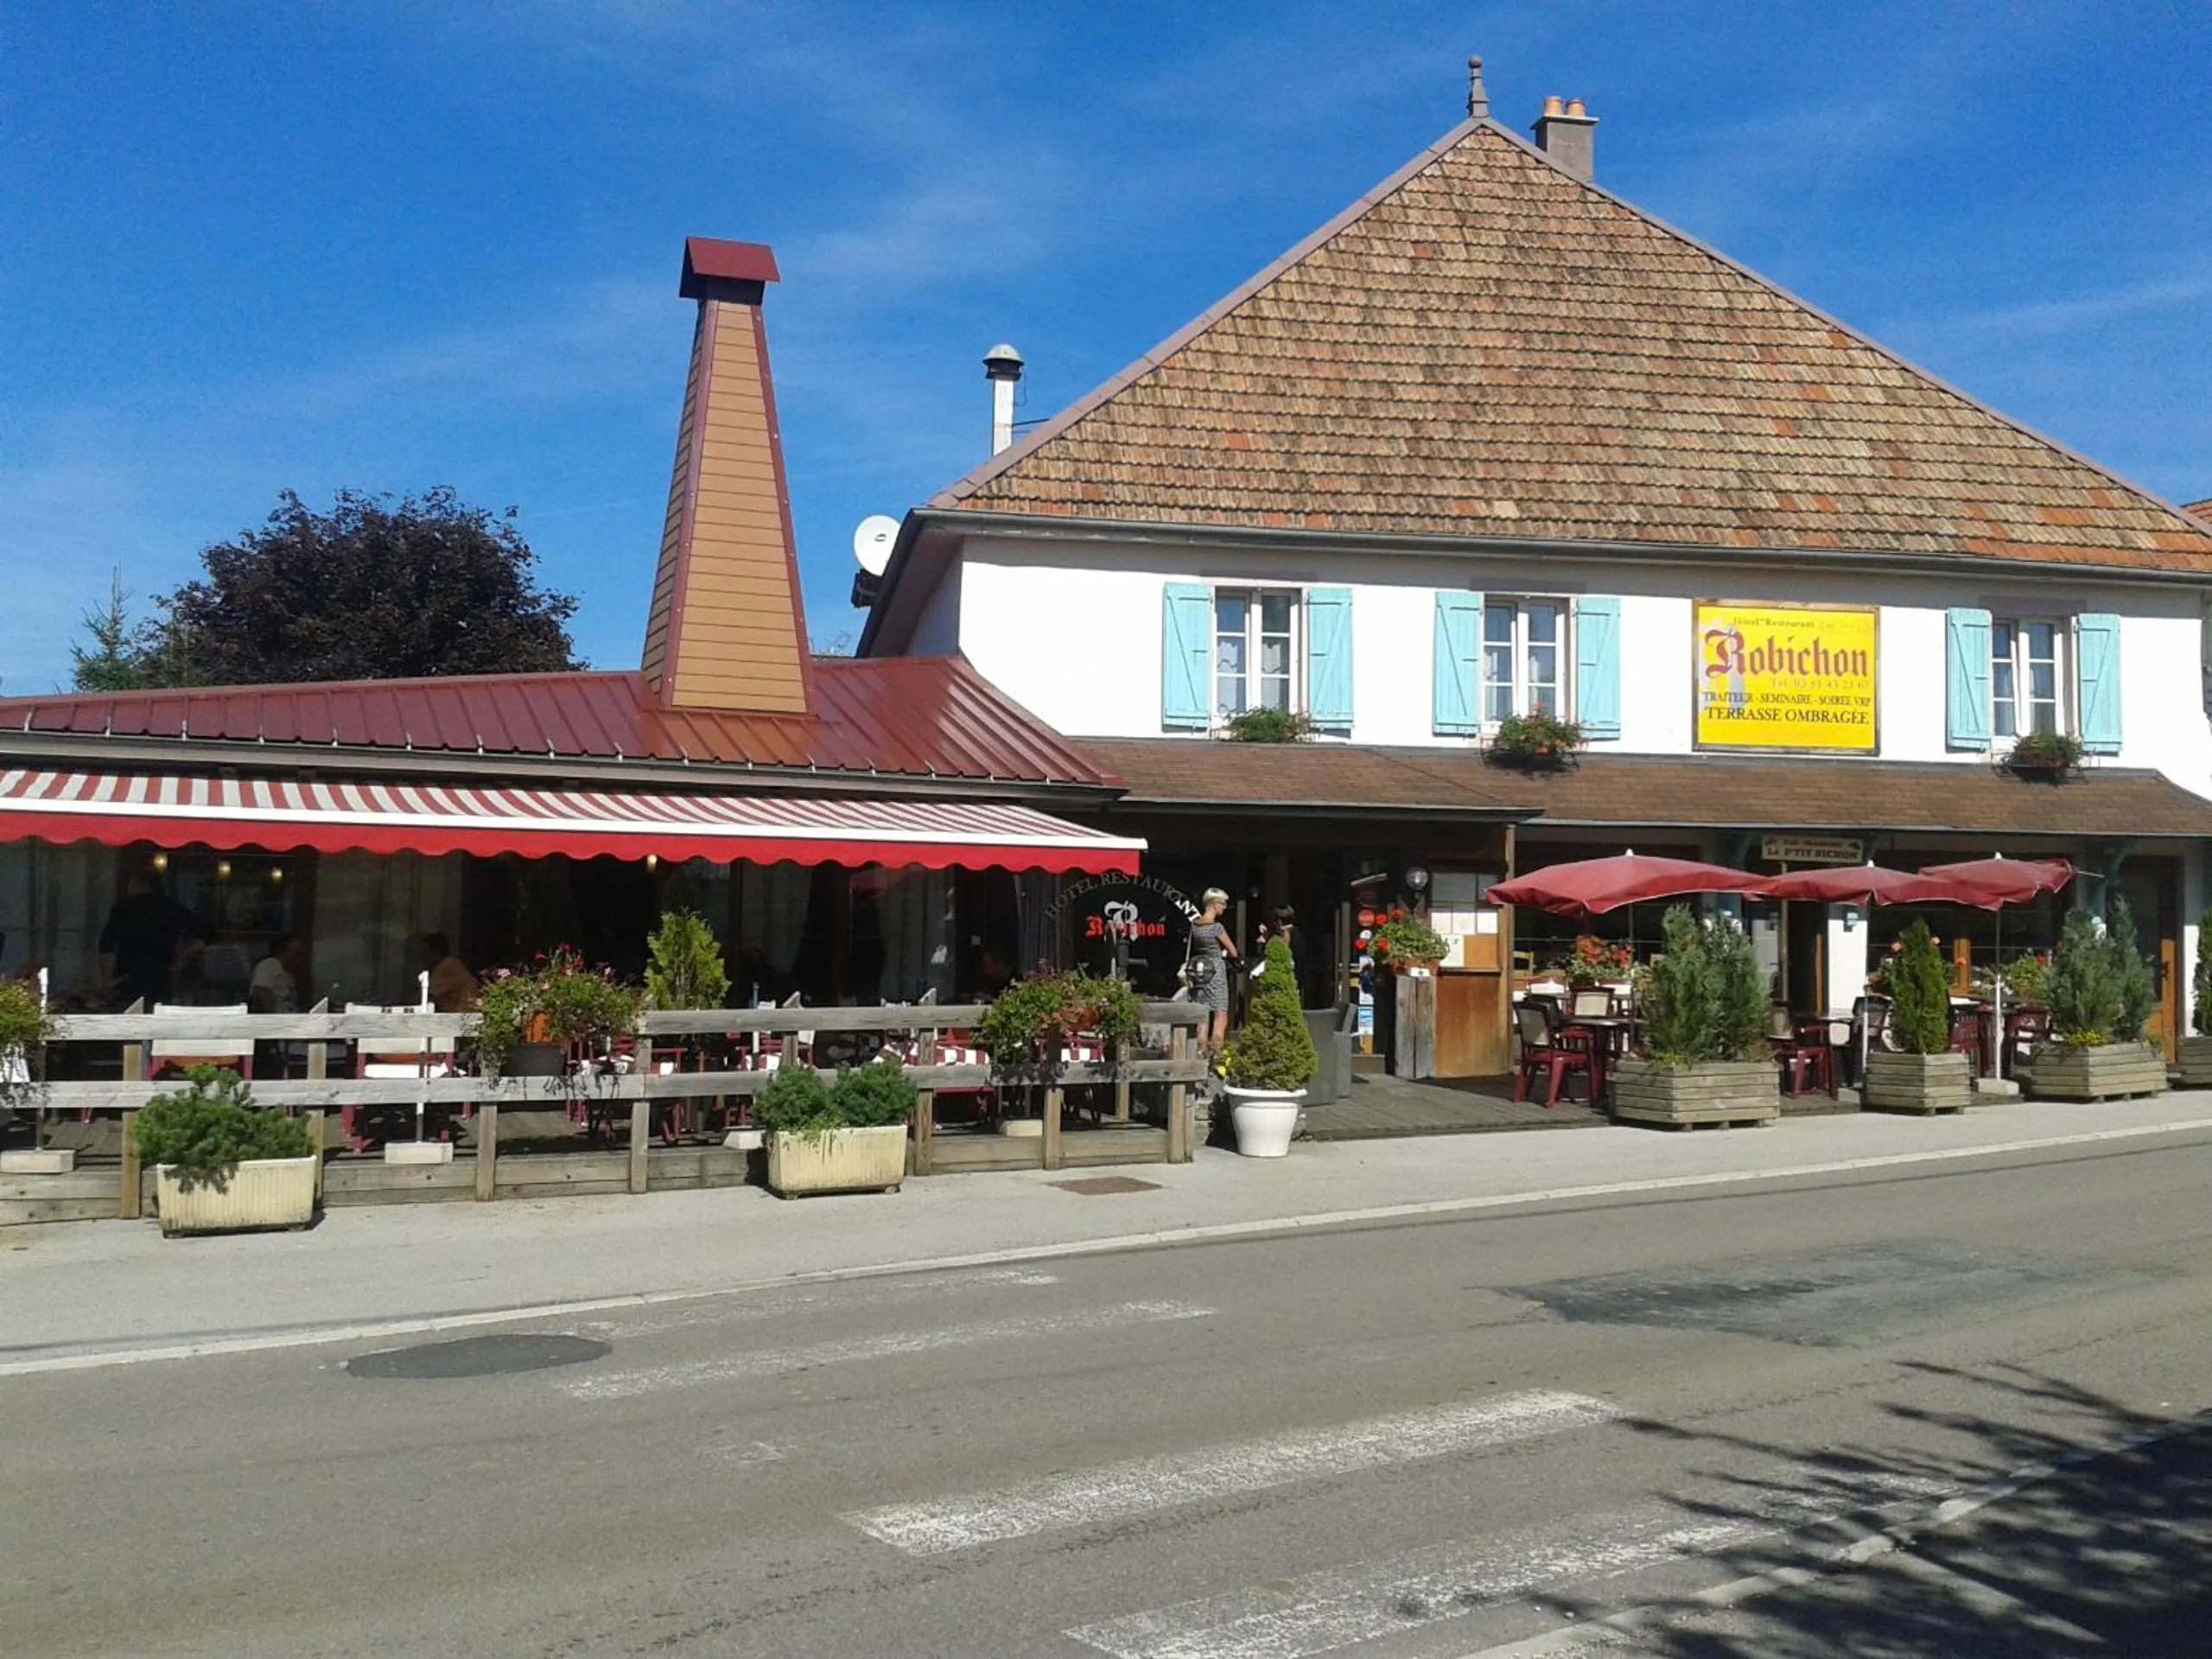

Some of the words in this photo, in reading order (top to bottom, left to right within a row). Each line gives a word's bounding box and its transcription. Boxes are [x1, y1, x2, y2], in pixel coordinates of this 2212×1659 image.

[1705, 629, 1868, 678] Robichon
[1703, 691, 1754, 703] TRAITEUR
[1705, 705, 1782, 721] TERRASSE
